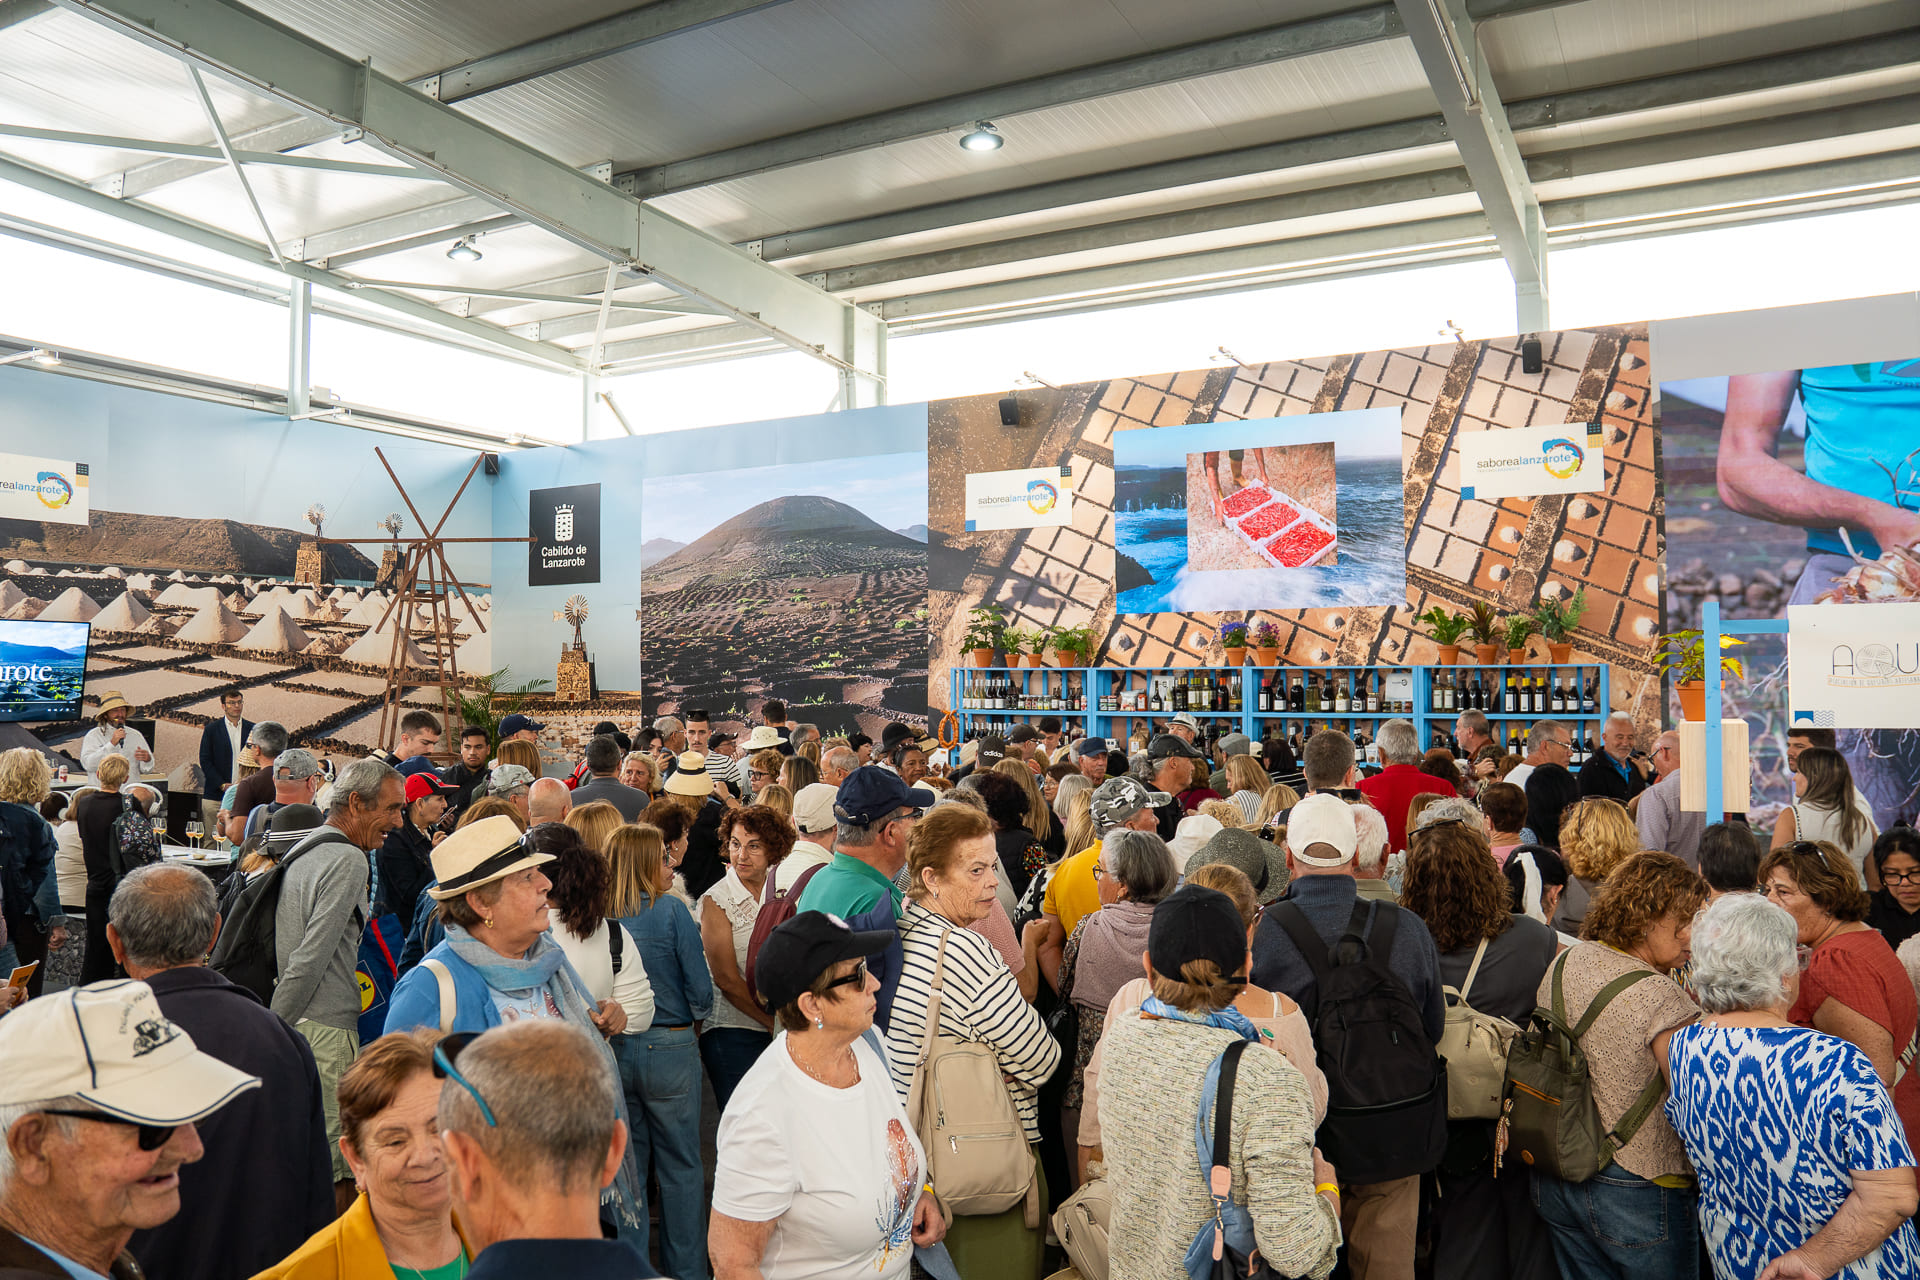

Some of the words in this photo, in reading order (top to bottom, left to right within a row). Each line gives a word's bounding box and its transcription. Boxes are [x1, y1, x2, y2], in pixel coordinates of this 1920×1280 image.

[1477, 453, 1571, 469] saborealanzarote
[977, 492, 1049, 505] saborealanzarote
[541, 545, 574, 557] Cabildo
[576, 544, 587, 554] de
[542, 556, 586, 569] Lanzarote
[983, 750, 1004, 758] adidas
